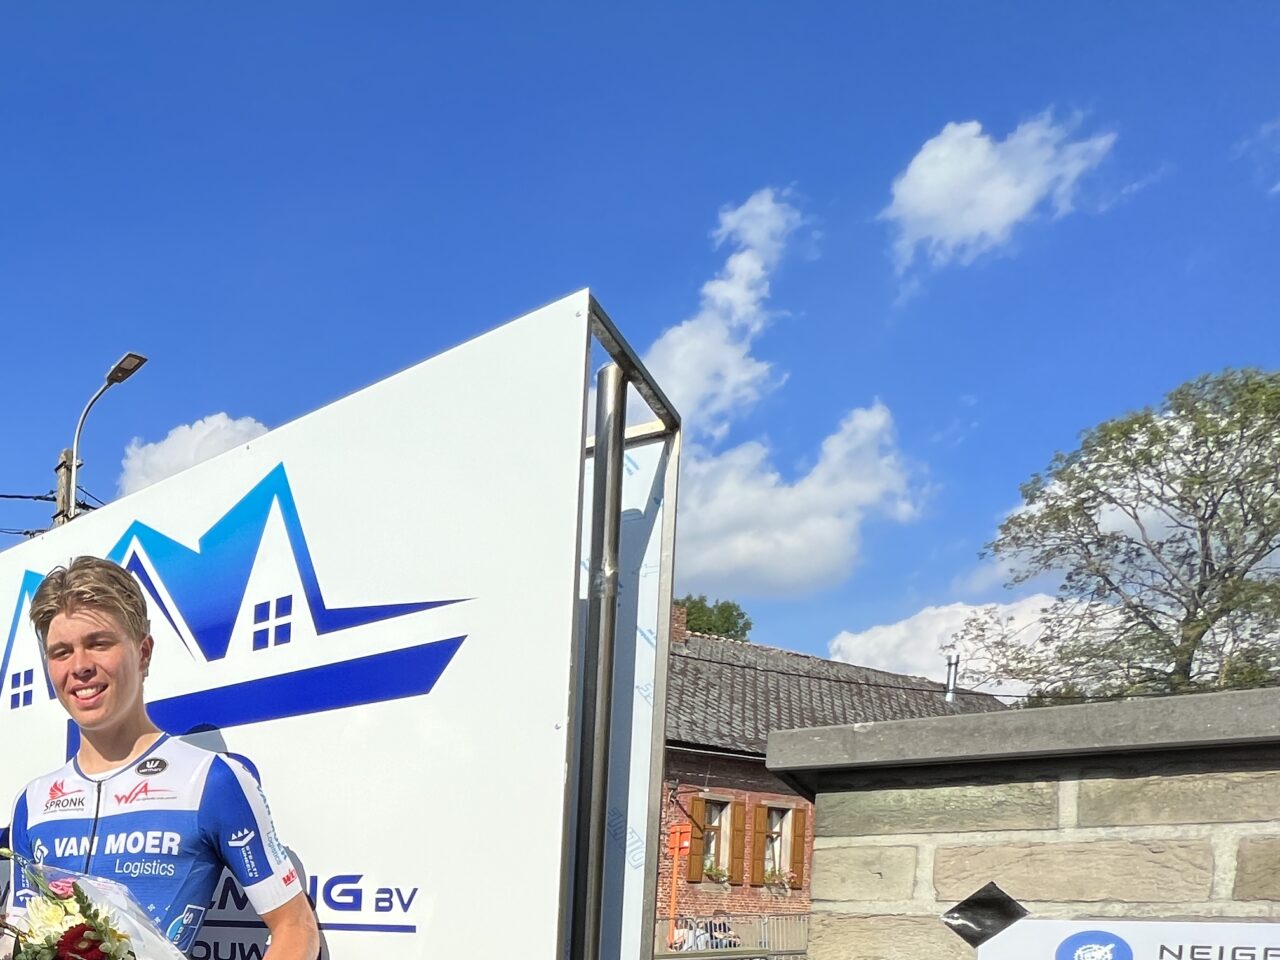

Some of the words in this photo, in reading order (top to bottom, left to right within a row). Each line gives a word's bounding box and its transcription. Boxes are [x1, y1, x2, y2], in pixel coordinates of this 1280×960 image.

[44, 797, 86, 812] SPRONK
[54, 836, 100, 858] VAN
[104, 831, 181, 855] MOER
[115, 859, 175, 878] Logistics
[375, 887, 418, 912] BV
